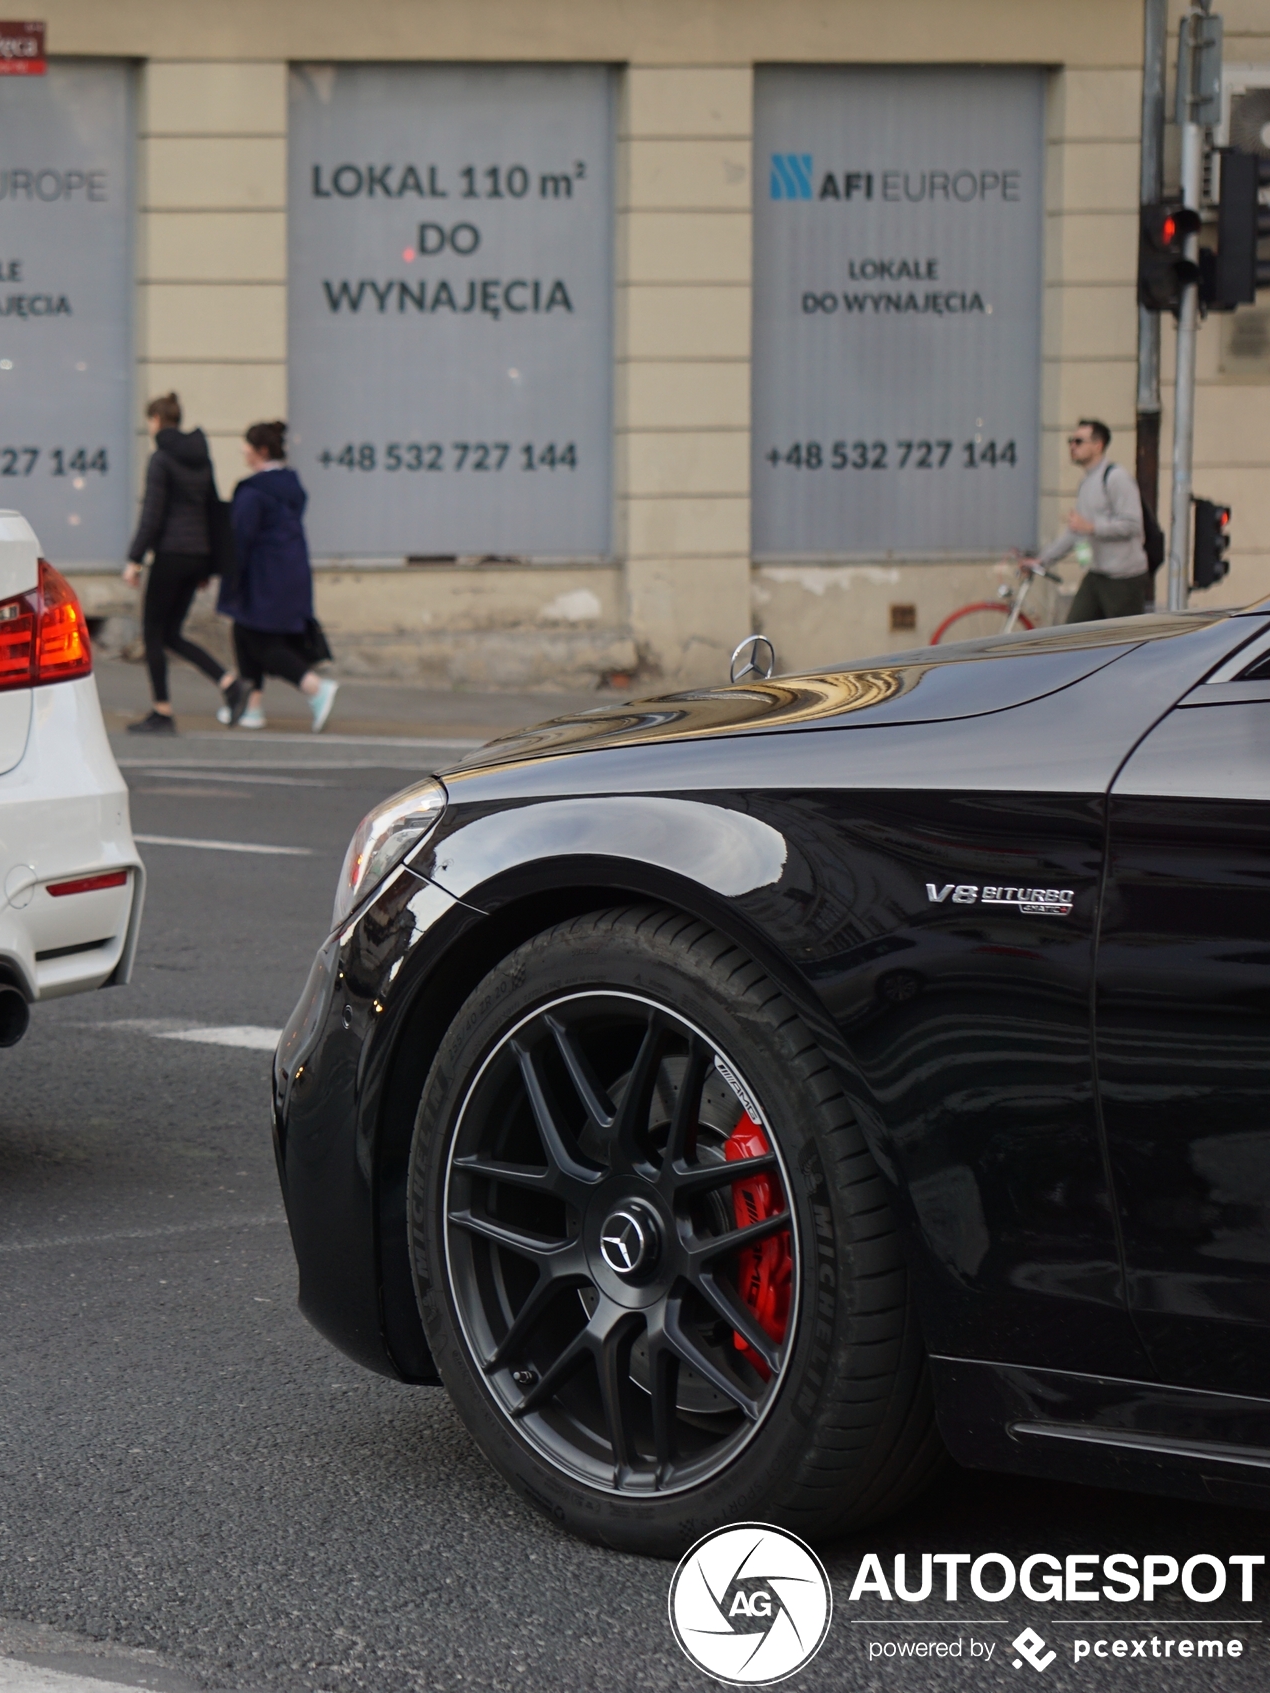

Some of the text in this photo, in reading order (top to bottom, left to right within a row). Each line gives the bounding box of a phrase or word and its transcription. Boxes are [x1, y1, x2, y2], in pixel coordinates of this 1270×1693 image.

[311, 164, 447, 198] LOKAL
[459, 165, 528, 198] 110
[820, 170, 1021, 201] AFI EUROPE
[418, 223, 480, 257] DO
[849, 259, 939, 280] LOKALE
[322, 279, 574, 320] WYNAJĘCIA
[803, 292, 985, 317] DO WYNAJĘCIA
[51, 448, 108, 475] 144
[319, 441, 577, 471] +48 532 727 144
[766, 440, 1017, 469] +48 532 727 144
[926, 884, 1074, 904] V8 BITURBO
[412, 1072, 448, 1278] MICHELIN
[797, 1204, 836, 1417] MICHELIN
